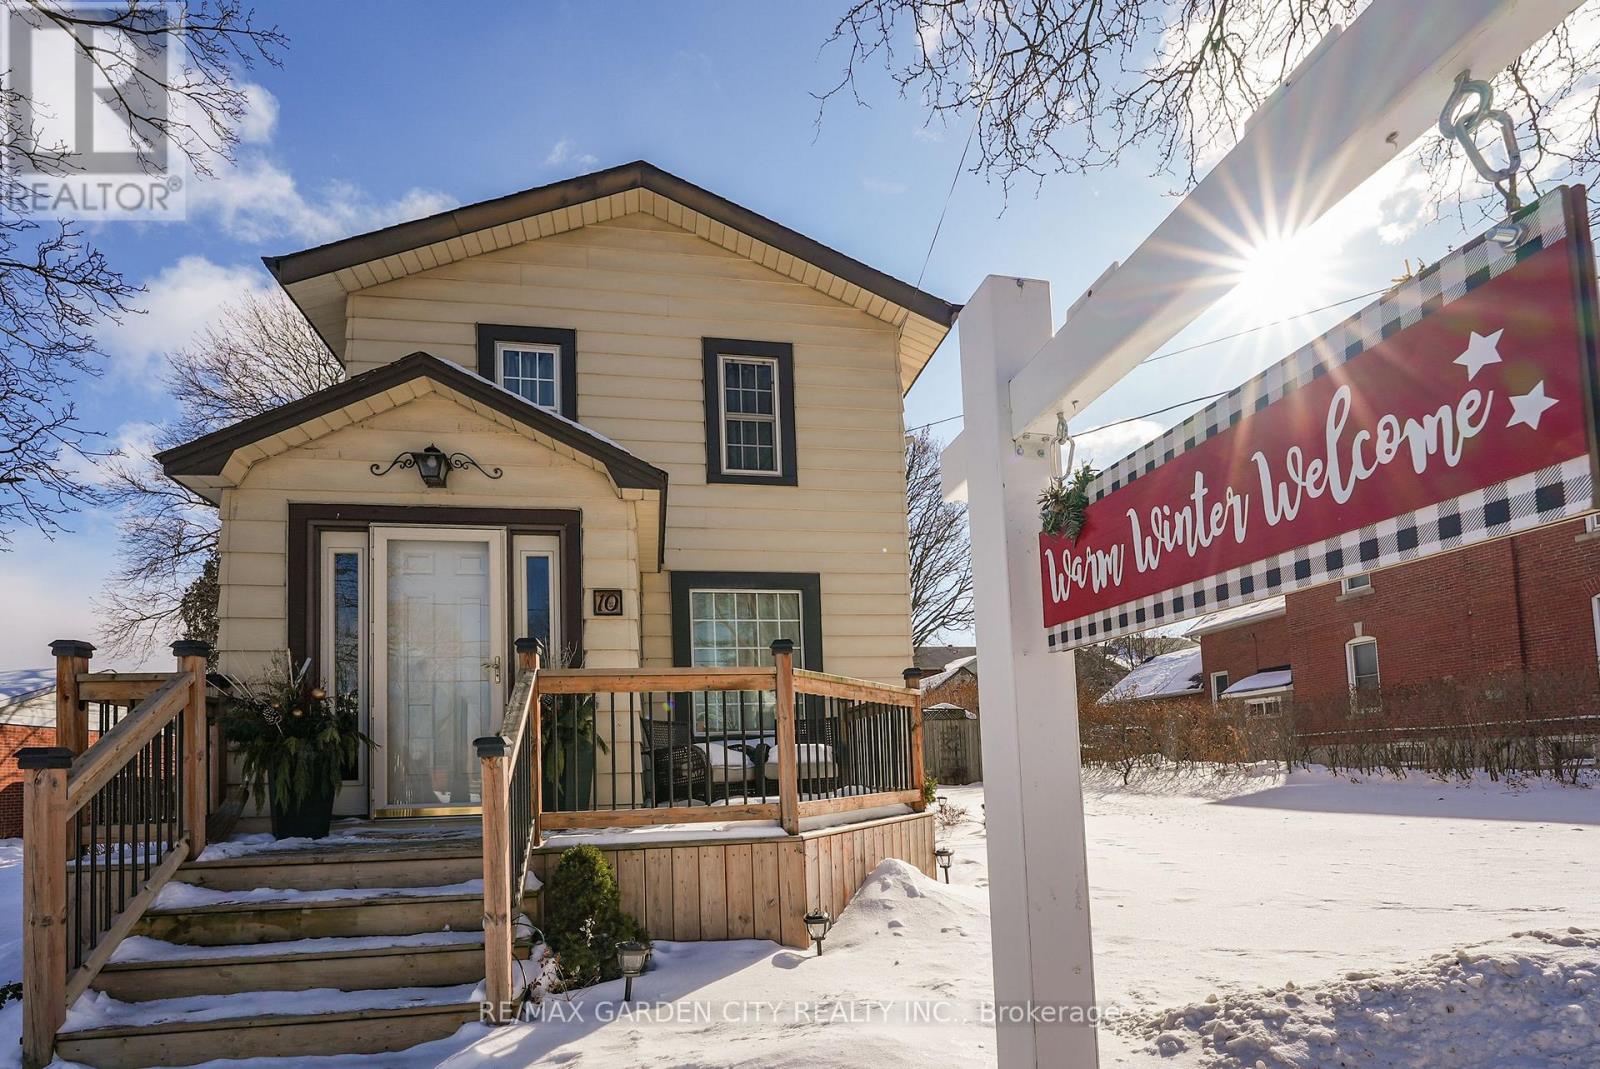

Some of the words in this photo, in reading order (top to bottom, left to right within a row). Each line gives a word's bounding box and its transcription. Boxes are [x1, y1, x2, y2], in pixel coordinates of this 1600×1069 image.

[1045, 543, 1125, 604] Warm
[1126, 470, 1250, 574] Winter
[1251, 384, 1495, 527] Welcome
[597, 593, 619, 612] 10
